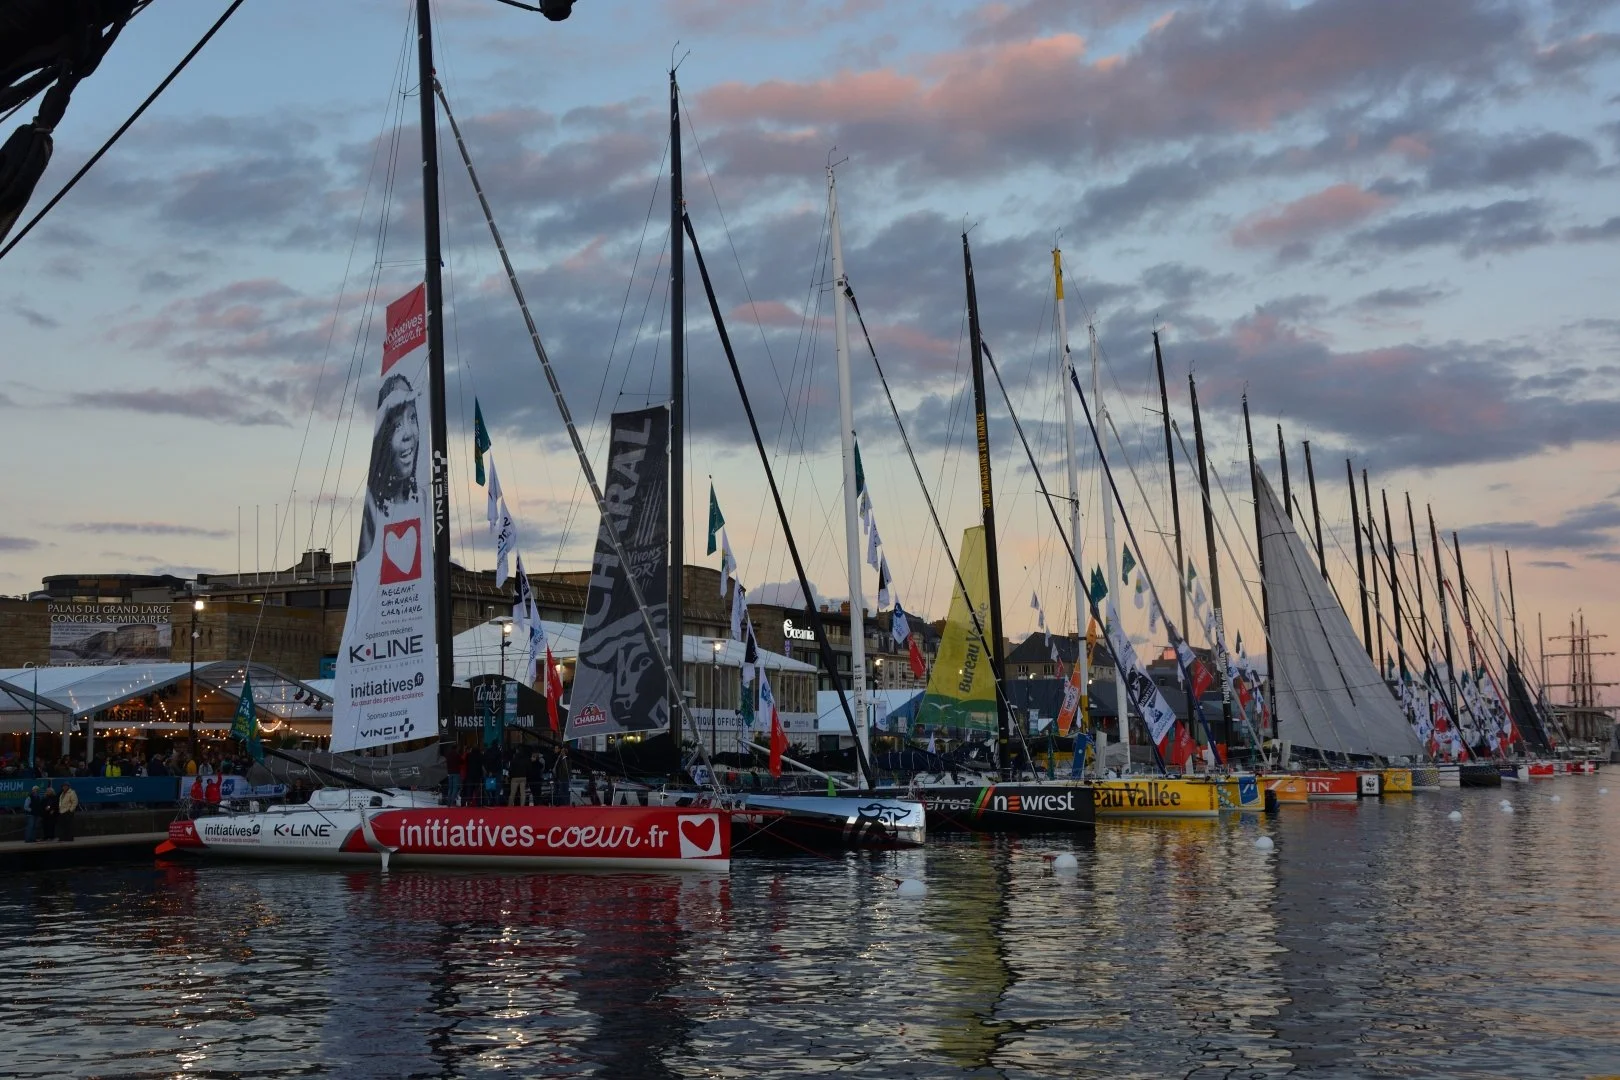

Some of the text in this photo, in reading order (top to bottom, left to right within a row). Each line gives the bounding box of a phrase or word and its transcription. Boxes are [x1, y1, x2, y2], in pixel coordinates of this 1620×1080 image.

[384, 314, 422, 345] initiatives
[434, 478, 444, 535] VINCI
[584, 417, 652, 629] CHARAL
[381, 594, 419, 606] CHIRURGIE
[47, 604, 171, 614] PALAIS DU GRAND LARGE
[381, 604, 423, 617] CARDIAQUE
[365, 630, 389, 640] Sponsors
[783, 618, 815, 641] Oceania
[959, 643, 980, 693] Bureau
[350, 677, 414, 699] initiatives
[373, 696, 383, 704] des
[383, 693, 400, 705] projets
[401, 691, 424, 701] scolaires
[367, 711, 389, 721] Sponsor
[574, 713, 605, 725] CHARAL
[360, 726, 397, 738] VINCI
[994, 790, 1075, 811] newrest
[1093, 782, 1180, 807] eau Vallée
[204, 824, 252, 837] initiatives
